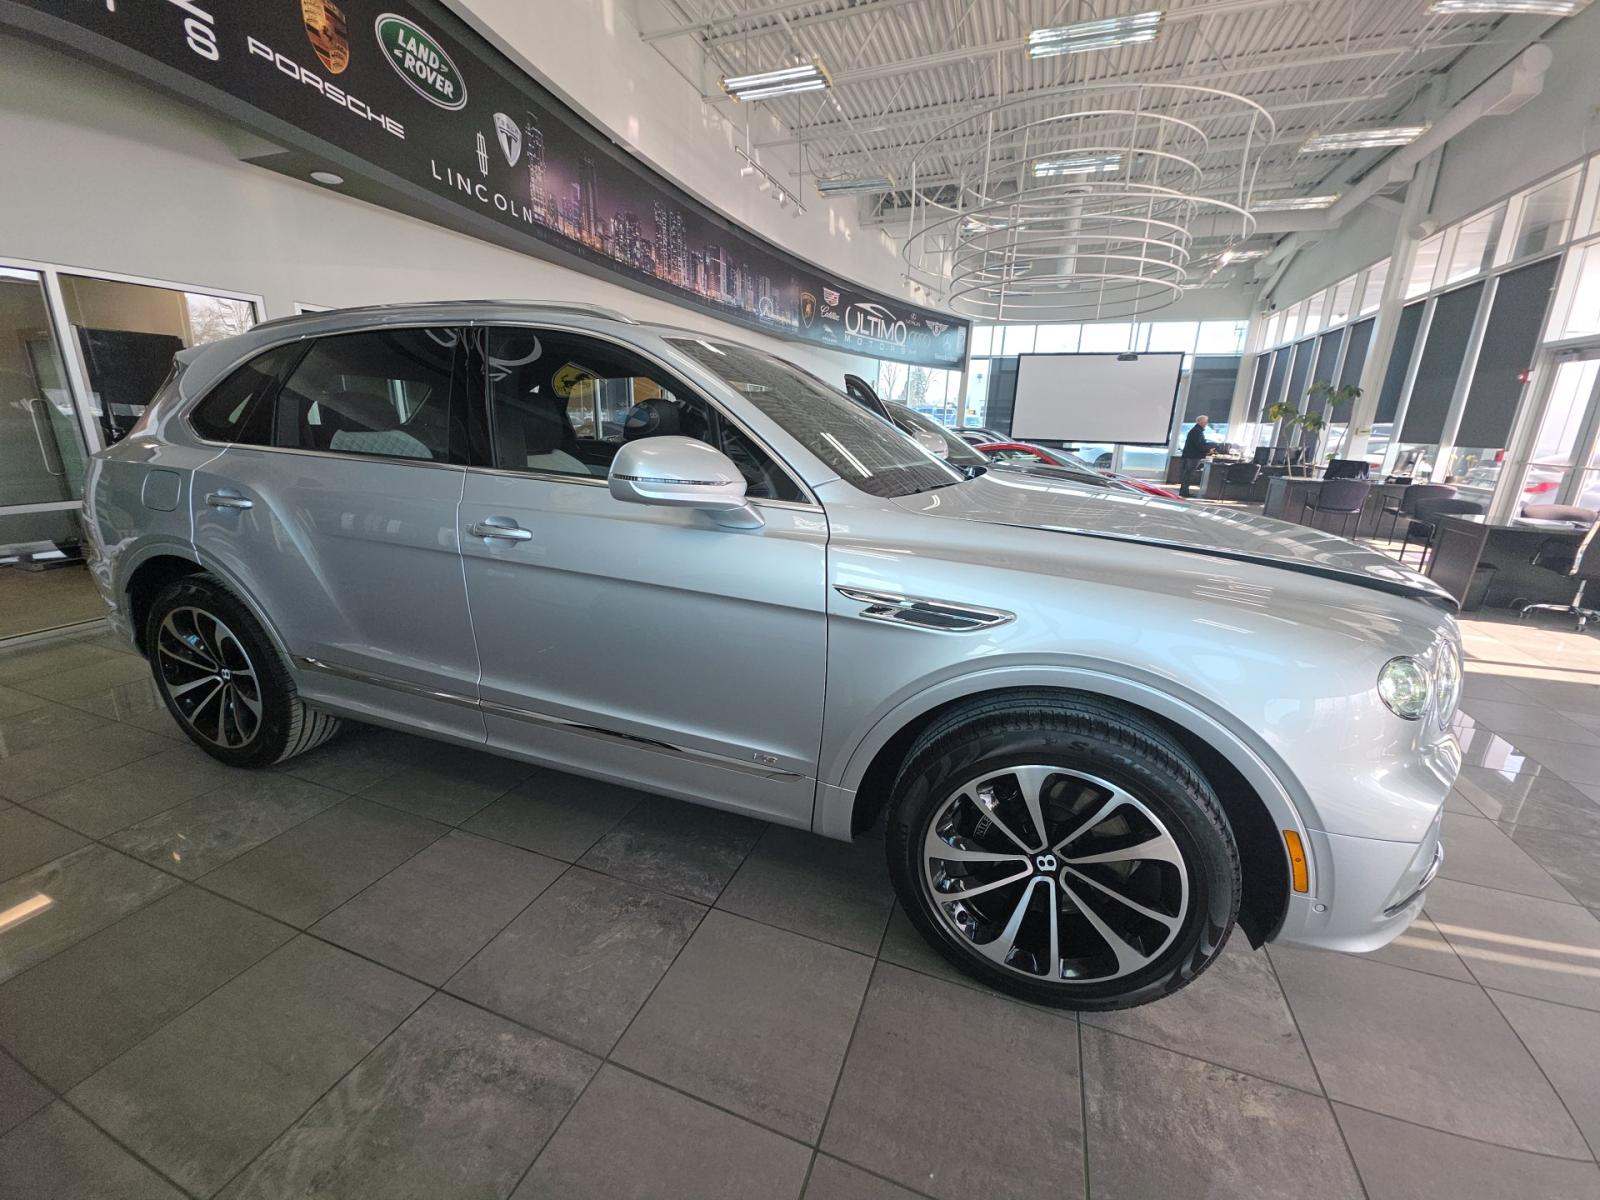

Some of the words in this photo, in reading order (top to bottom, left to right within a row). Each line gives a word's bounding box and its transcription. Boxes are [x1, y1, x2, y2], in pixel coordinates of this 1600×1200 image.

[398, 28, 439, 69] LAND
[246, 35, 406, 140] PORSCHE
[403, 52, 454, 99] ROVER
[430, 159, 533, 224] LINCOLN
[844, 305, 907, 347] ULTIMO
[844, 335, 906, 355] MOTORS
